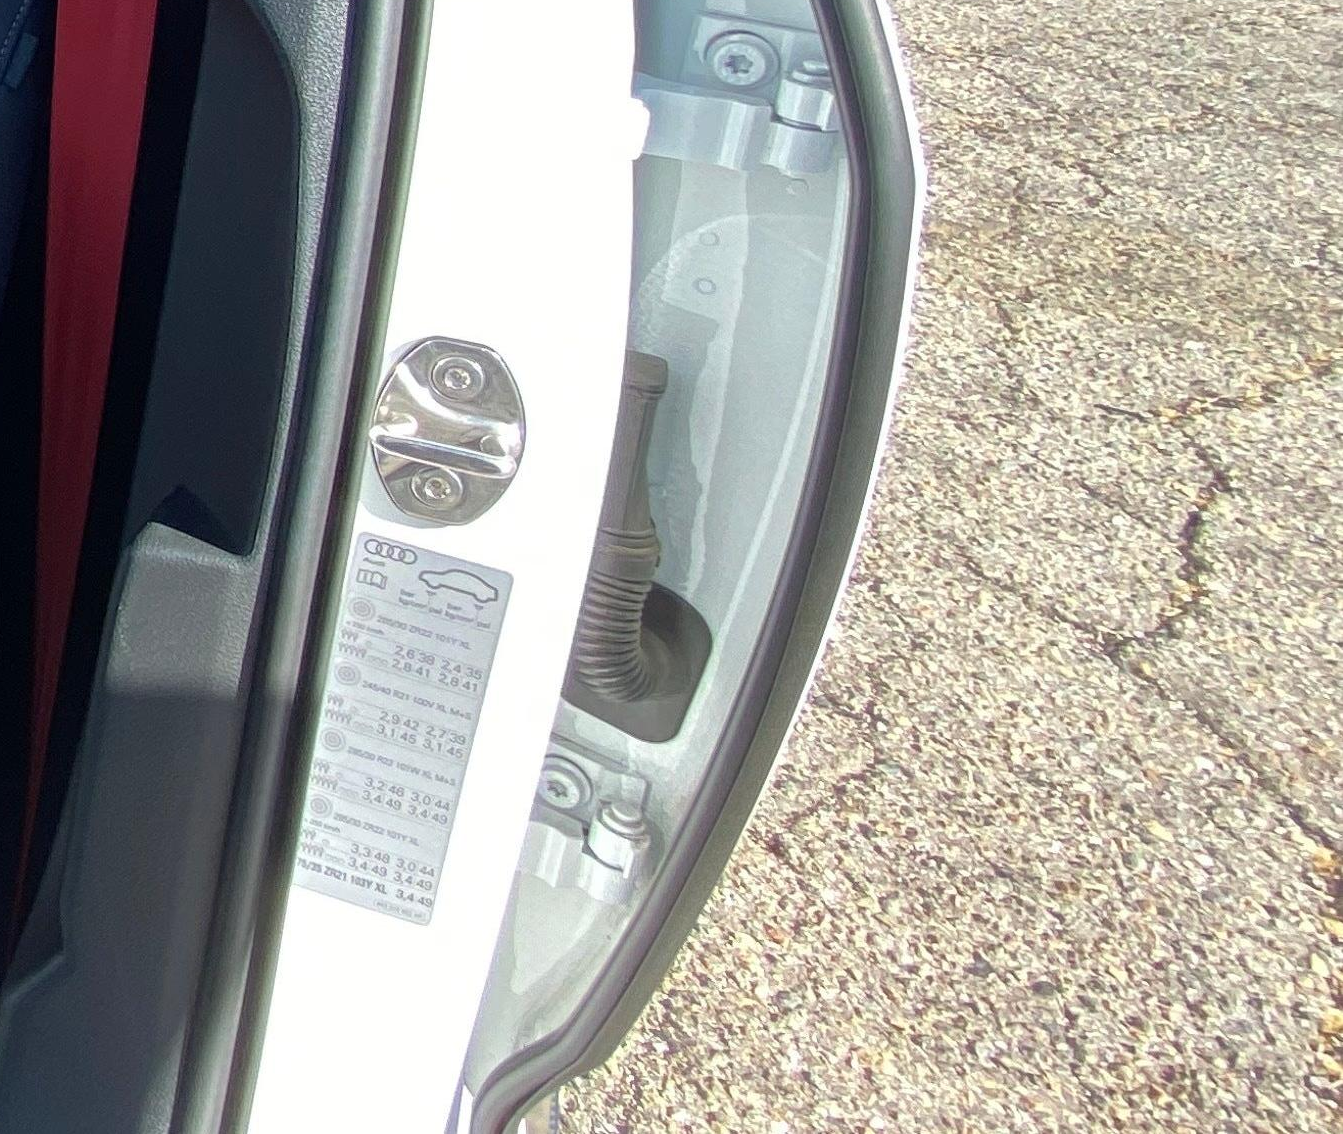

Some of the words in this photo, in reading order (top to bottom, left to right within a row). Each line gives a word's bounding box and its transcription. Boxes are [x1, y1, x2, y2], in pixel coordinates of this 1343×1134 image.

[392, 659, 412, 673] 2,8
[415, 666, 430, 678] 41
[438, 673, 459, 687] 2,8
[463, 680, 478, 692] 41
[394, 645, 415, 660] 2,6
[418, 652, 435, 665] 38
[441, 659, 462, 674] 2,4
[466, 667, 483, 680] 35
[376, 726, 395, 738] 3,1
[400, 733, 417, 744] 45
[422, 738, 442, 753] 3,1
[447, 746, 463, 758] 45
[379, 711, 400, 725] 2,9
[403, 719, 420, 731] 42
[425, 725, 447, 739] 2,7
[450, 733, 466, 745] 39
[362, 790, 382, 804] 3,4
[386, 797, 401, 810] 49
[408, 805, 428, 819] 3,4
[431, 812, 448, 825] 49
[364, 777, 385, 791] 3,2
[411, 792, 431, 806] 3,0
[435, 799, 450, 811] 44
[348, 856, 368, 871] 3,4
[371, 864, 388, 877] 49
[393, 871, 413, 885] 3,4
[416, 879, 433, 891] 49
[351, 843, 371, 857] 3,3
[374, 851, 390, 864] 48
[396, 858, 416, 872] 3,0
[419, 866, 435, 877] 44
[374, 882, 387, 895] XL
[396, 889, 414, 903] 3,4
[417, 895, 432, 908] 49
